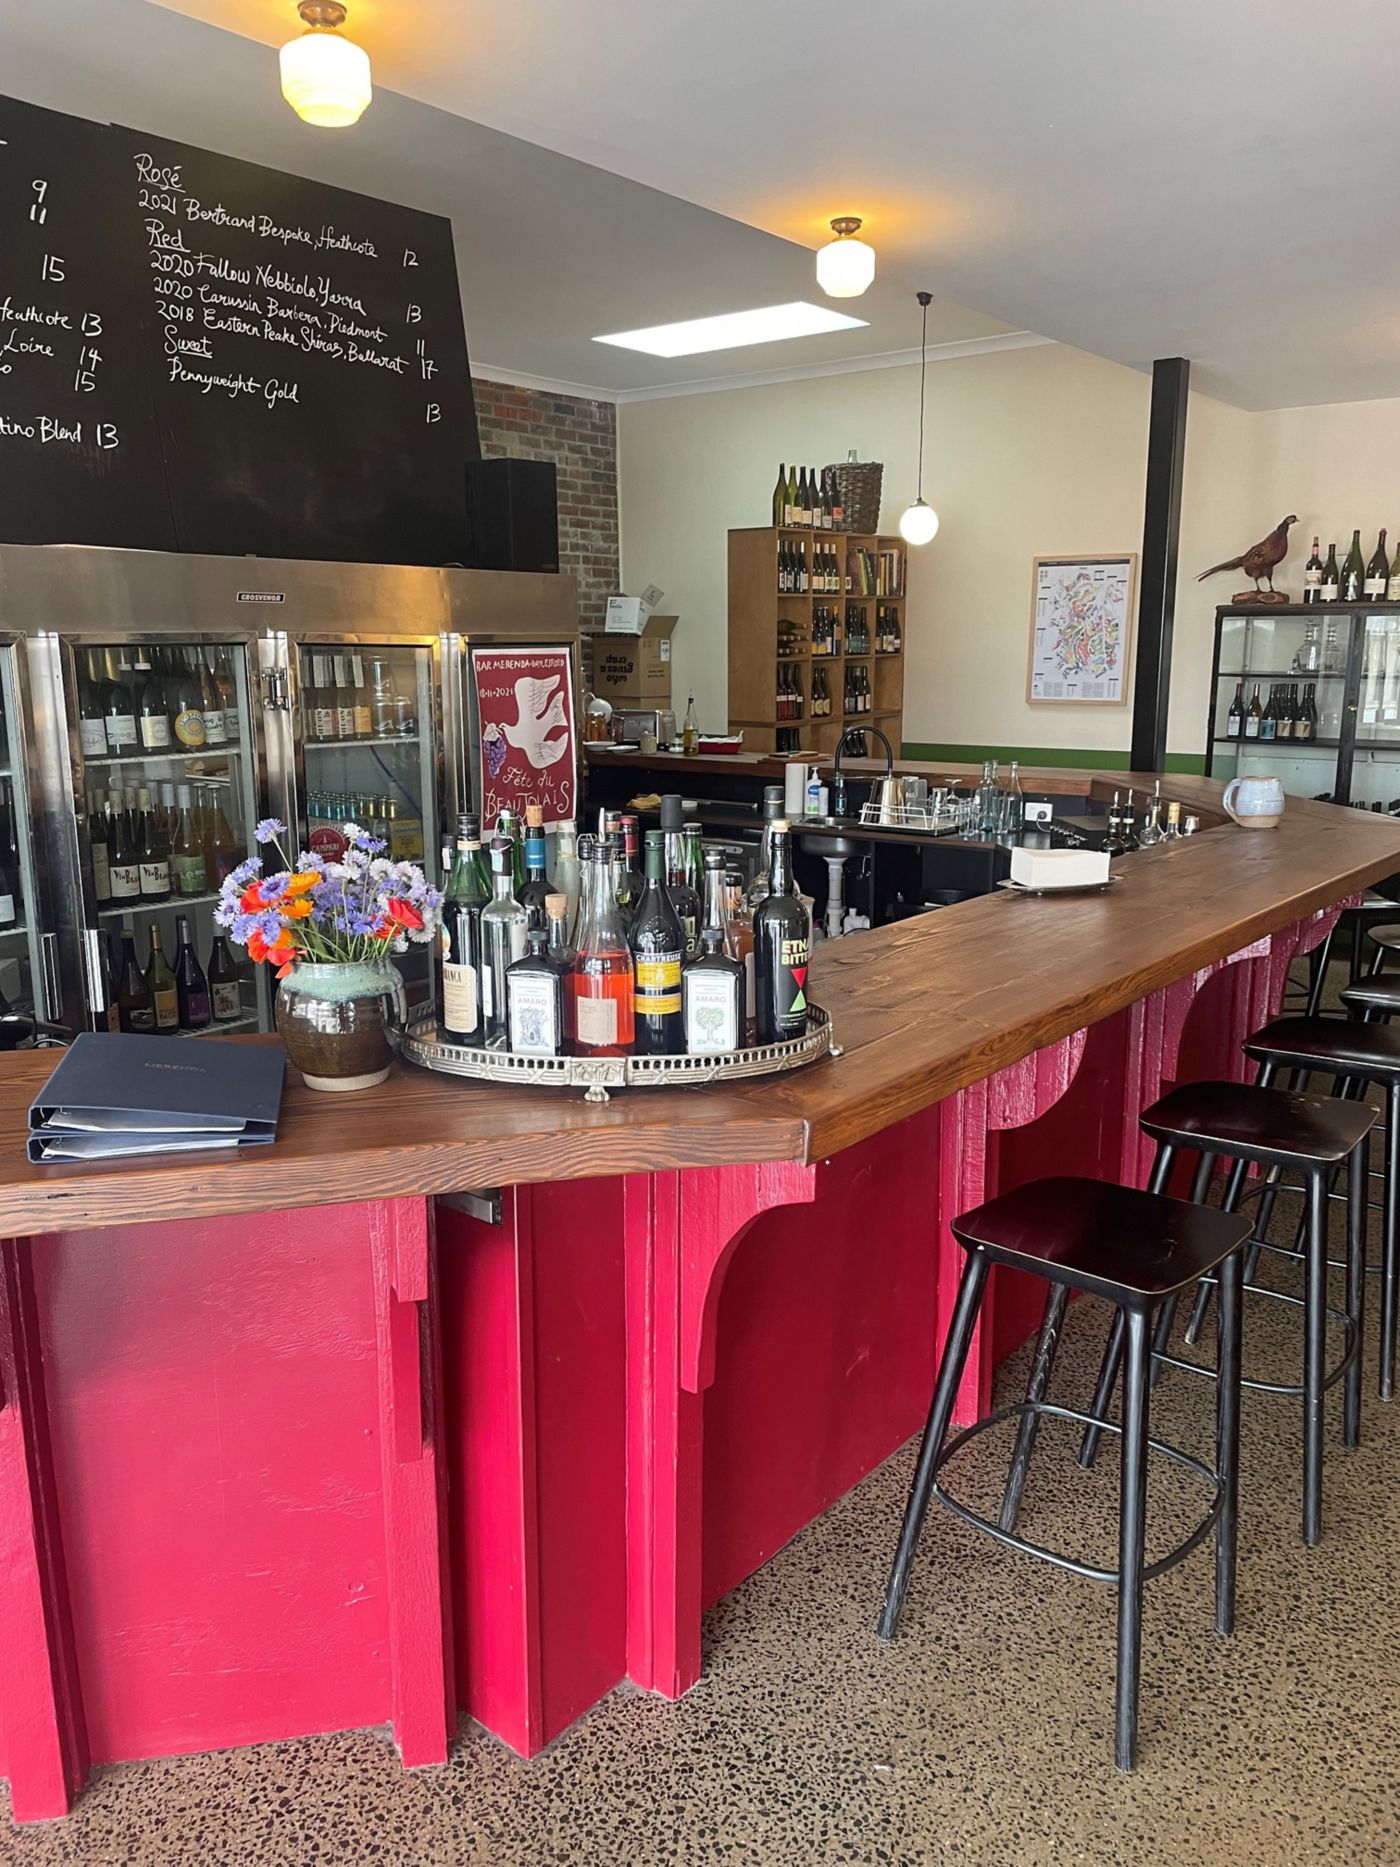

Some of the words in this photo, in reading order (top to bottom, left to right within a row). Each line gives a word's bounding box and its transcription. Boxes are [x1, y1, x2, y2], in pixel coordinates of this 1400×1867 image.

[133, 153, 184, 191] Rosé
[32, 179, 48, 203] 9
[30, 204, 47, 224] 11
[138, 189, 177, 215] 2021
[183, 198, 255, 233] Bertrand
[403, 249, 419, 267] 12
[144, 218, 187, 250] Red
[42, 254, 65, 281] 15
[150, 250, 194, 278] 2020
[193, 252, 250, 284] Fallow
[406, 304, 422, 323] 13
[81, 313, 102, 336] 13
[153, 277, 193, 300] 2020
[197, 284, 262, 314] Carussin
[326, 312, 388, 342] Piedmont
[416, 339, 425, 357] 11
[4, 328, 54, 356] Loire
[80, 346, 102, 371] 14
[155, 300, 194, 322] 2018
[203, 307, 261, 337] Eastern
[261, 319, 299, 346] Peake
[421, 358, 438, 380] 17
[164, 324, 213, 356] Sweet
[75, 369, 95, 391] 15
[167, 356, 262, 398] Pennyweight
[264, 379, 299, 409] Gold
[426, 403, 441, 423] 13
[35, 416, 81, 443] Blend
[97, 424, 119, 449] 13
[240, 594, 281, 602] GROSVENOR
[476, 661, 492, 672] BAR
[538, 769, 555, 788] du
[635, 954, 681, 963] CHARTREUSE
[517, 997, 548, 1006] AMARO
[694, 995, 727, 1004] AMARO
